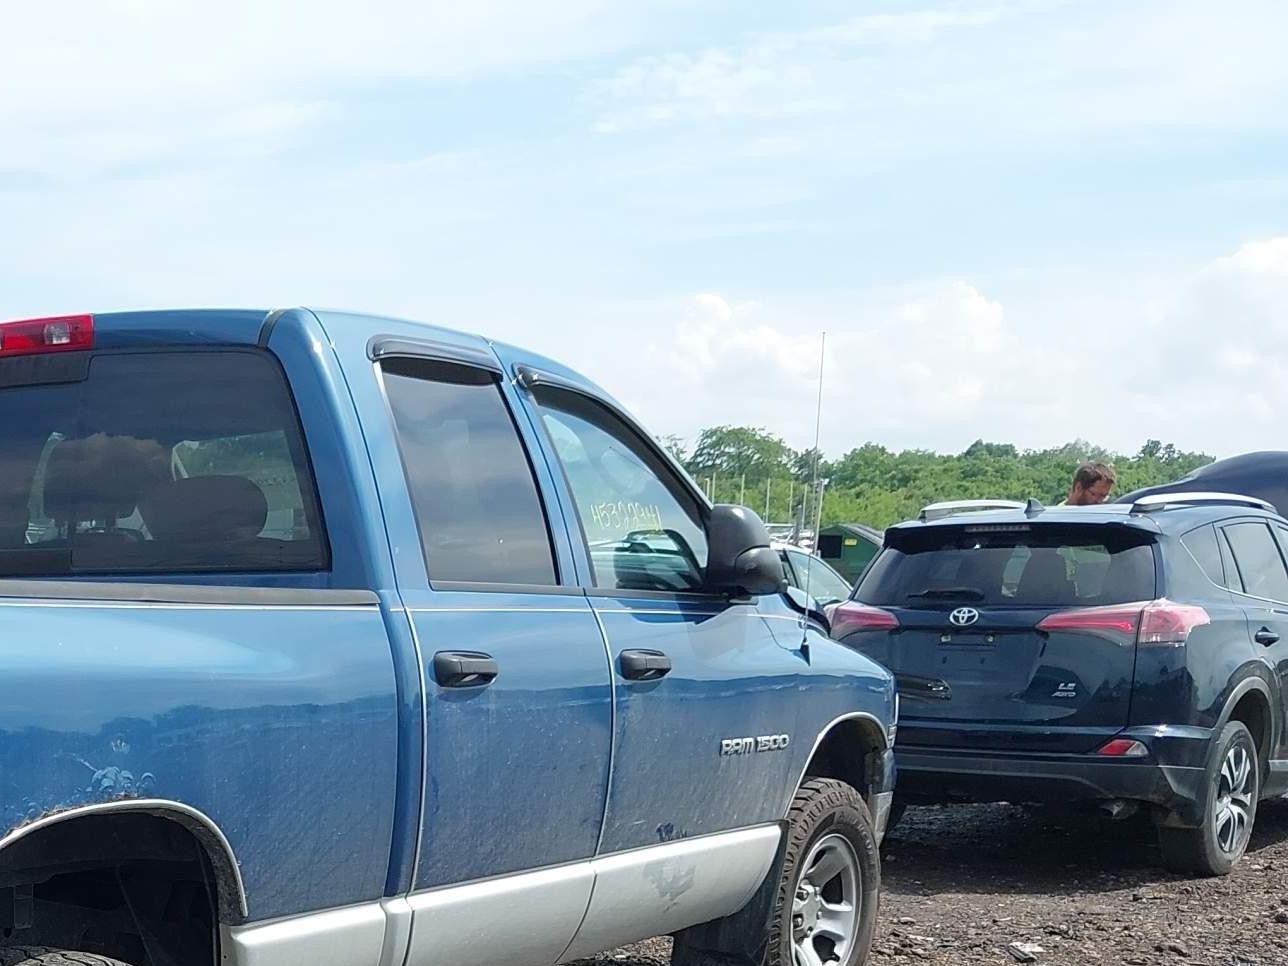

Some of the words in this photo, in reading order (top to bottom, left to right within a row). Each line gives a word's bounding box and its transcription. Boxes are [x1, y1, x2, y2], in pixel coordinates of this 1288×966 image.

[590, 501, 662, 531] 45322941
[720, 737, 754, 755] RAM
[756, 734, 790, 752] 1500
